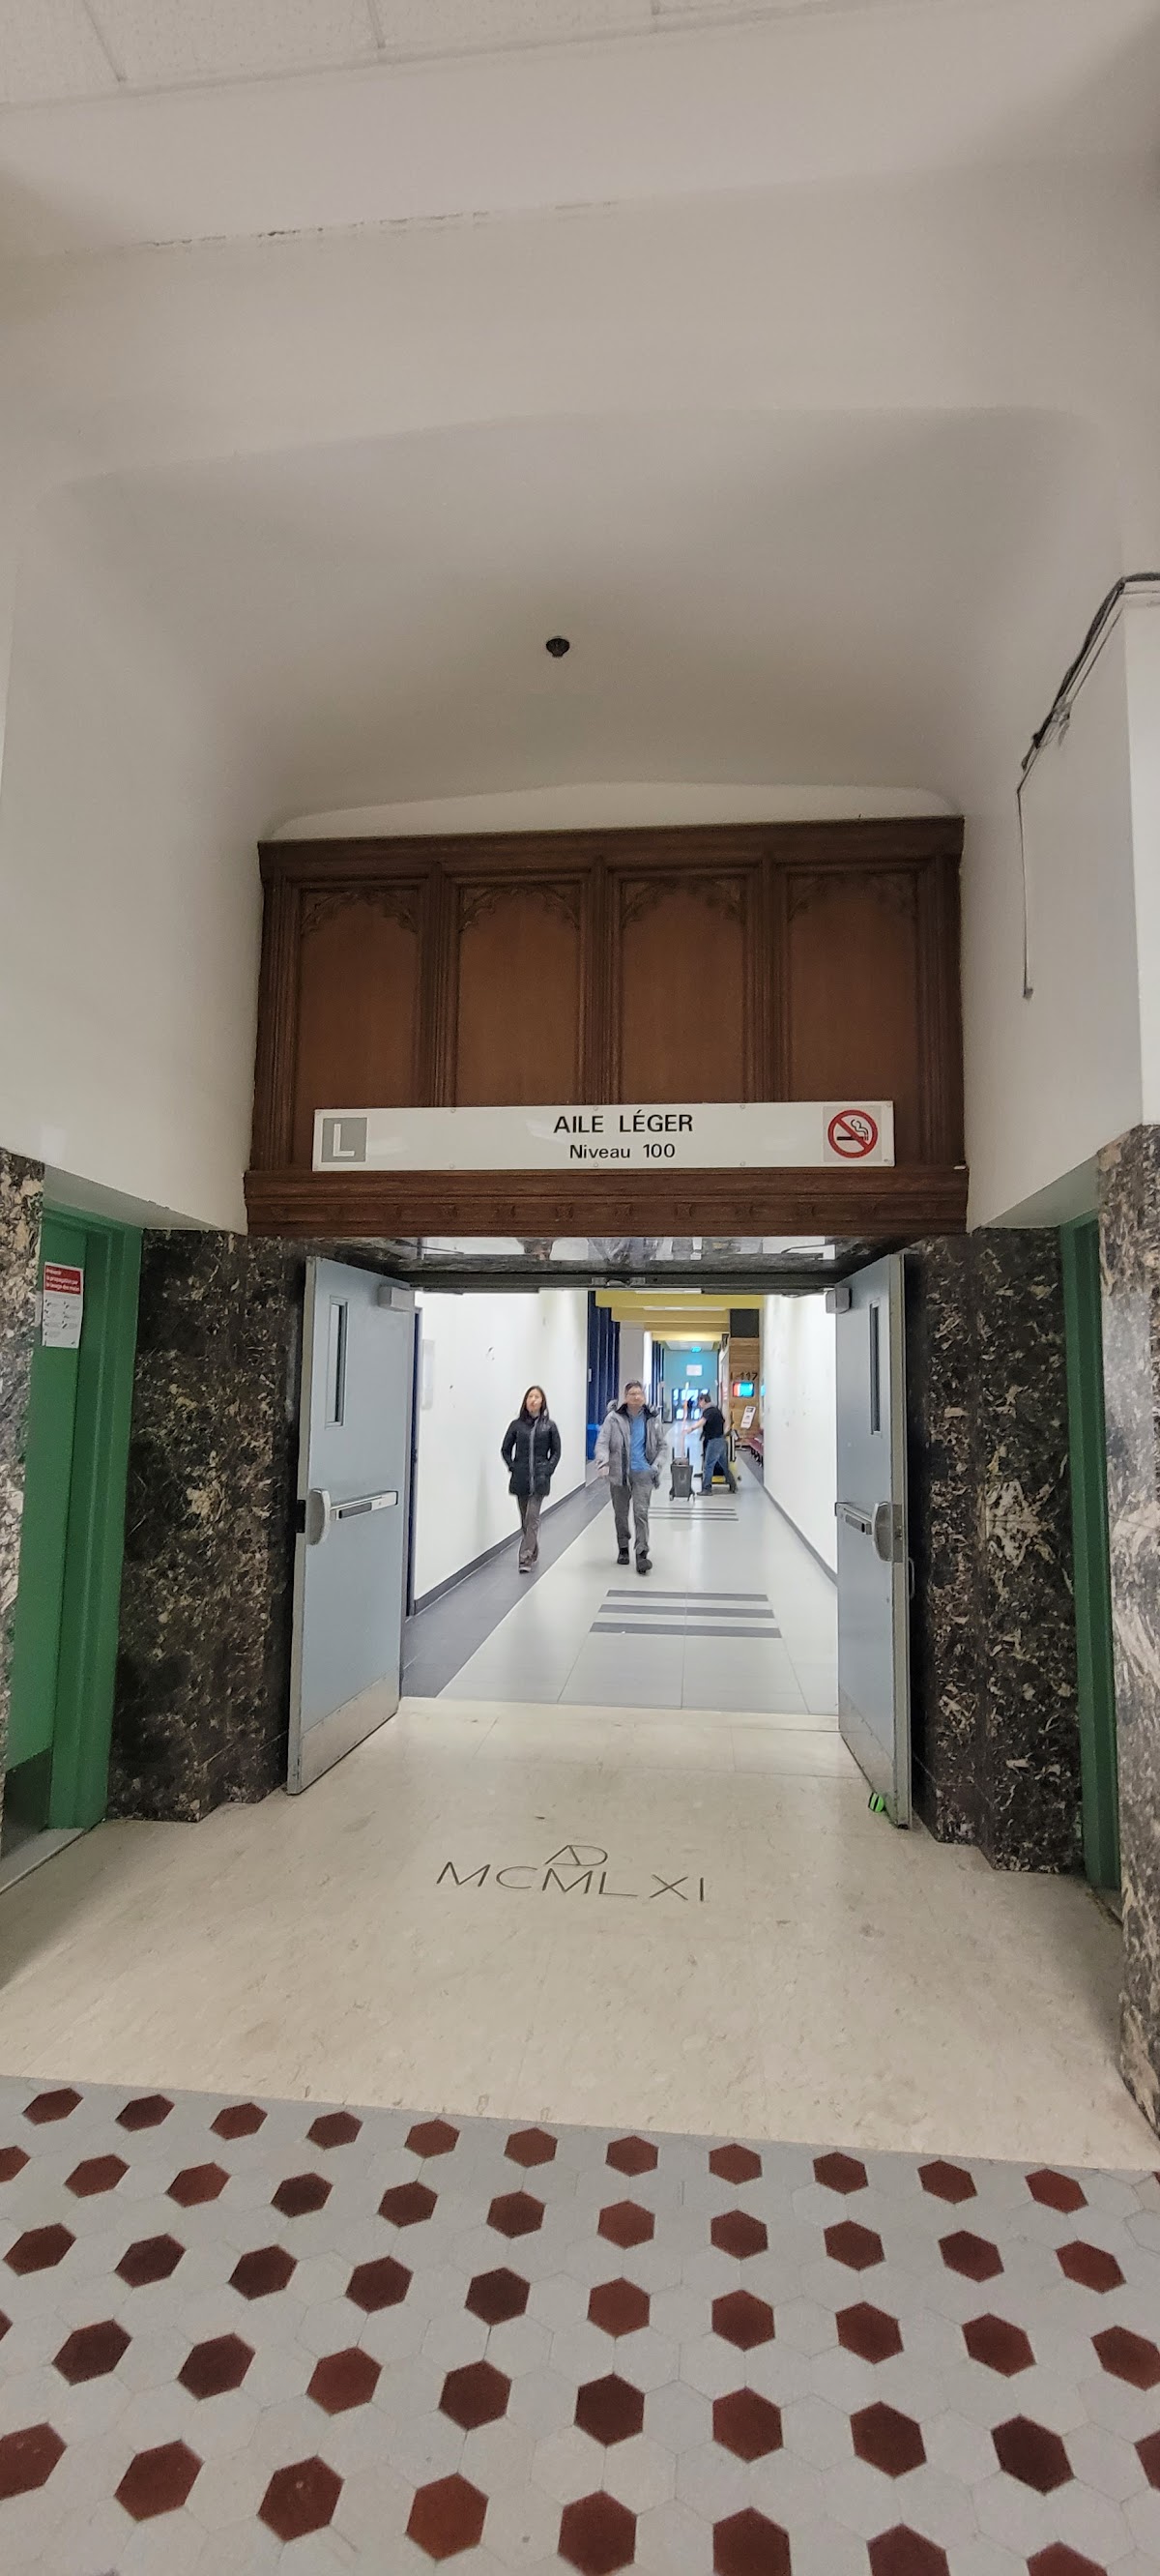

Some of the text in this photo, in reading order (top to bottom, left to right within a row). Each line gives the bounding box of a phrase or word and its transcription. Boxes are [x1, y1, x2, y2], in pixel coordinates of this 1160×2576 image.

[553, 1109, 693, 1133] AILE LÉGER
[333, 1123, 355, 1157] L
[569, 1143, 676, 1158] Niveau 100
[544, 1845, 608, 1867] AD
